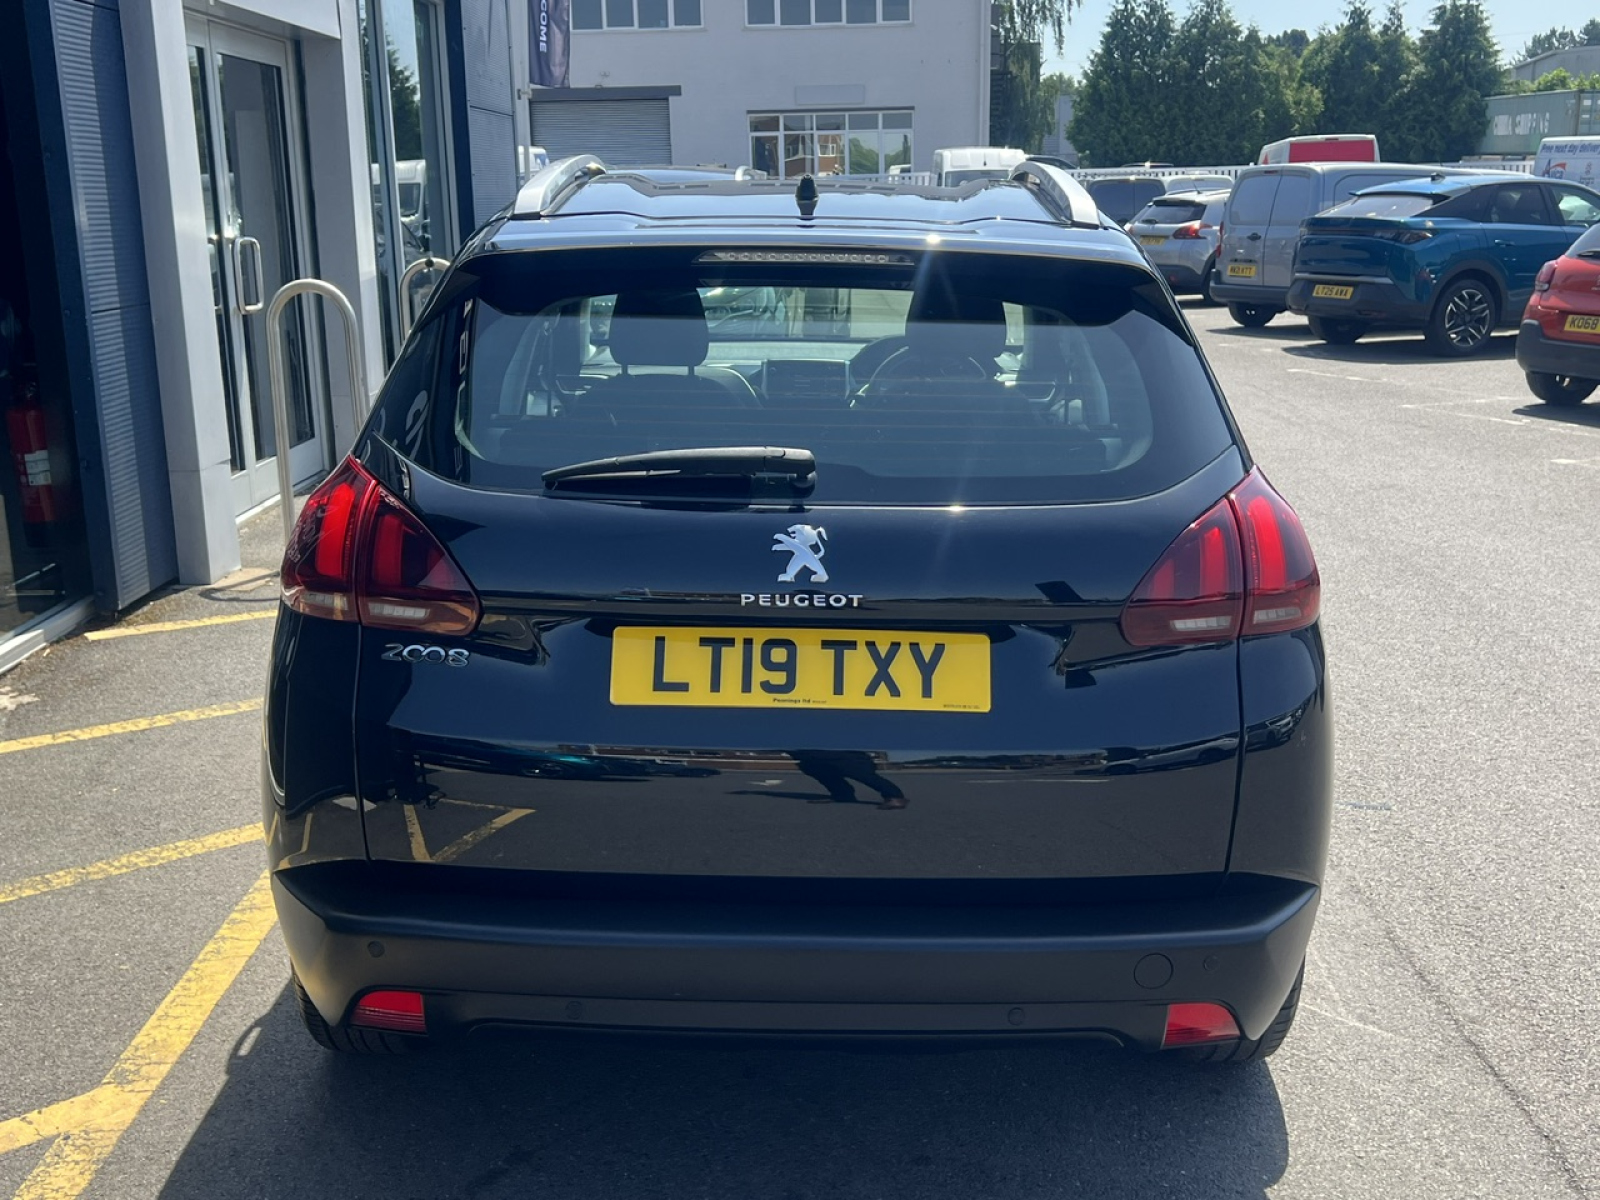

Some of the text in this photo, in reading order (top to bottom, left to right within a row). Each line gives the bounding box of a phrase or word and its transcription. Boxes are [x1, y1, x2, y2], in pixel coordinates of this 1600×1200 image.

[1554, 144, 1567, 153] next
[1568, 143, 1579, 155] day
[740, 593, 863, 607] PEUGEOT
[381, 643, 470, 667] 2008
[652, 635, 946, 699] LT19 TXY
